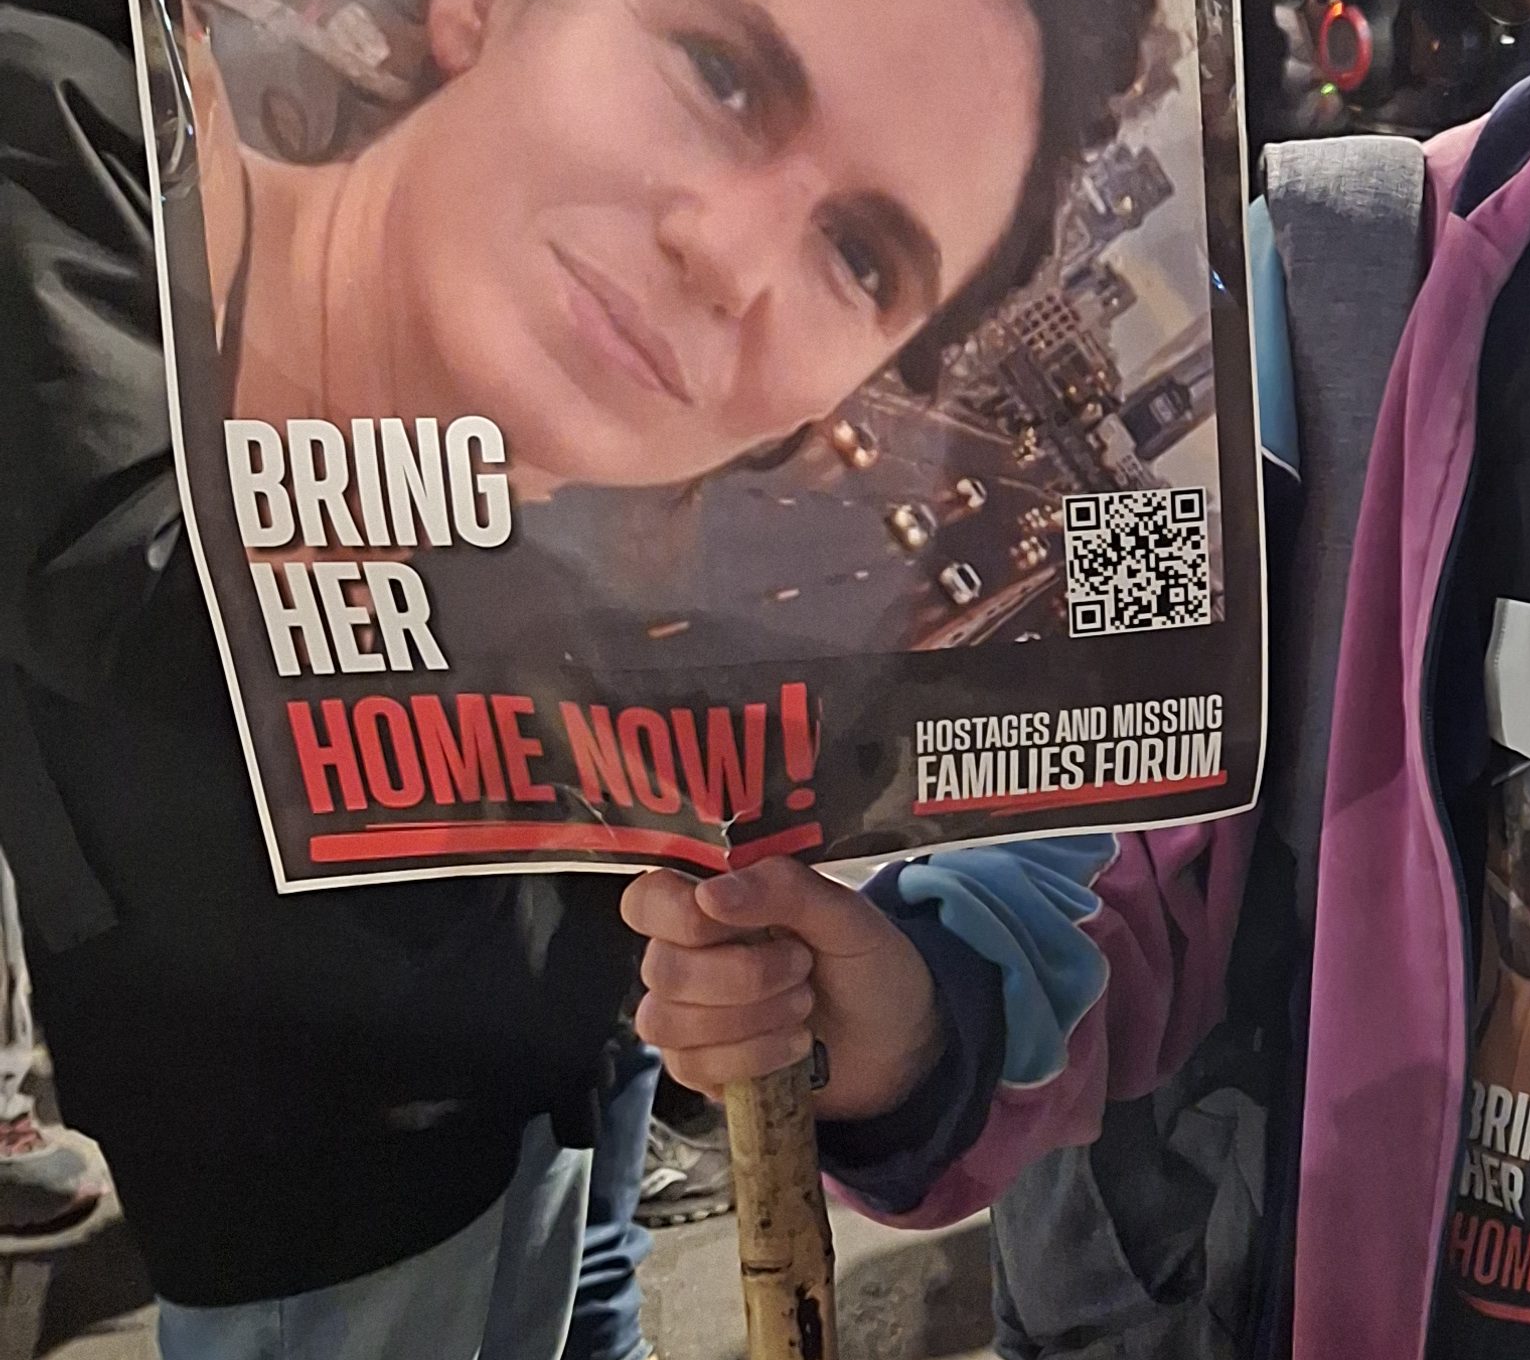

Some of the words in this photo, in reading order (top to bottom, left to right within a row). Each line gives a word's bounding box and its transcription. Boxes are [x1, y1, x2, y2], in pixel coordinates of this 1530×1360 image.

[223, 416, 513, 549] BRING
[251, 561, 449, 676] HER
[287, 693, 556, 814] HOME
[560, 682, 821, 825] NOW!
[916, 712, 1050, 754] HOSTAGES
[1055, 706, 1107, 744] AND
[1113, 694, 1223, 738] MISSING
[917, 744, 1085, 803] FAMILIES
[1095, 731, 1223, 788] FORUM
[1459, 1148, 1525, 1221] HER
